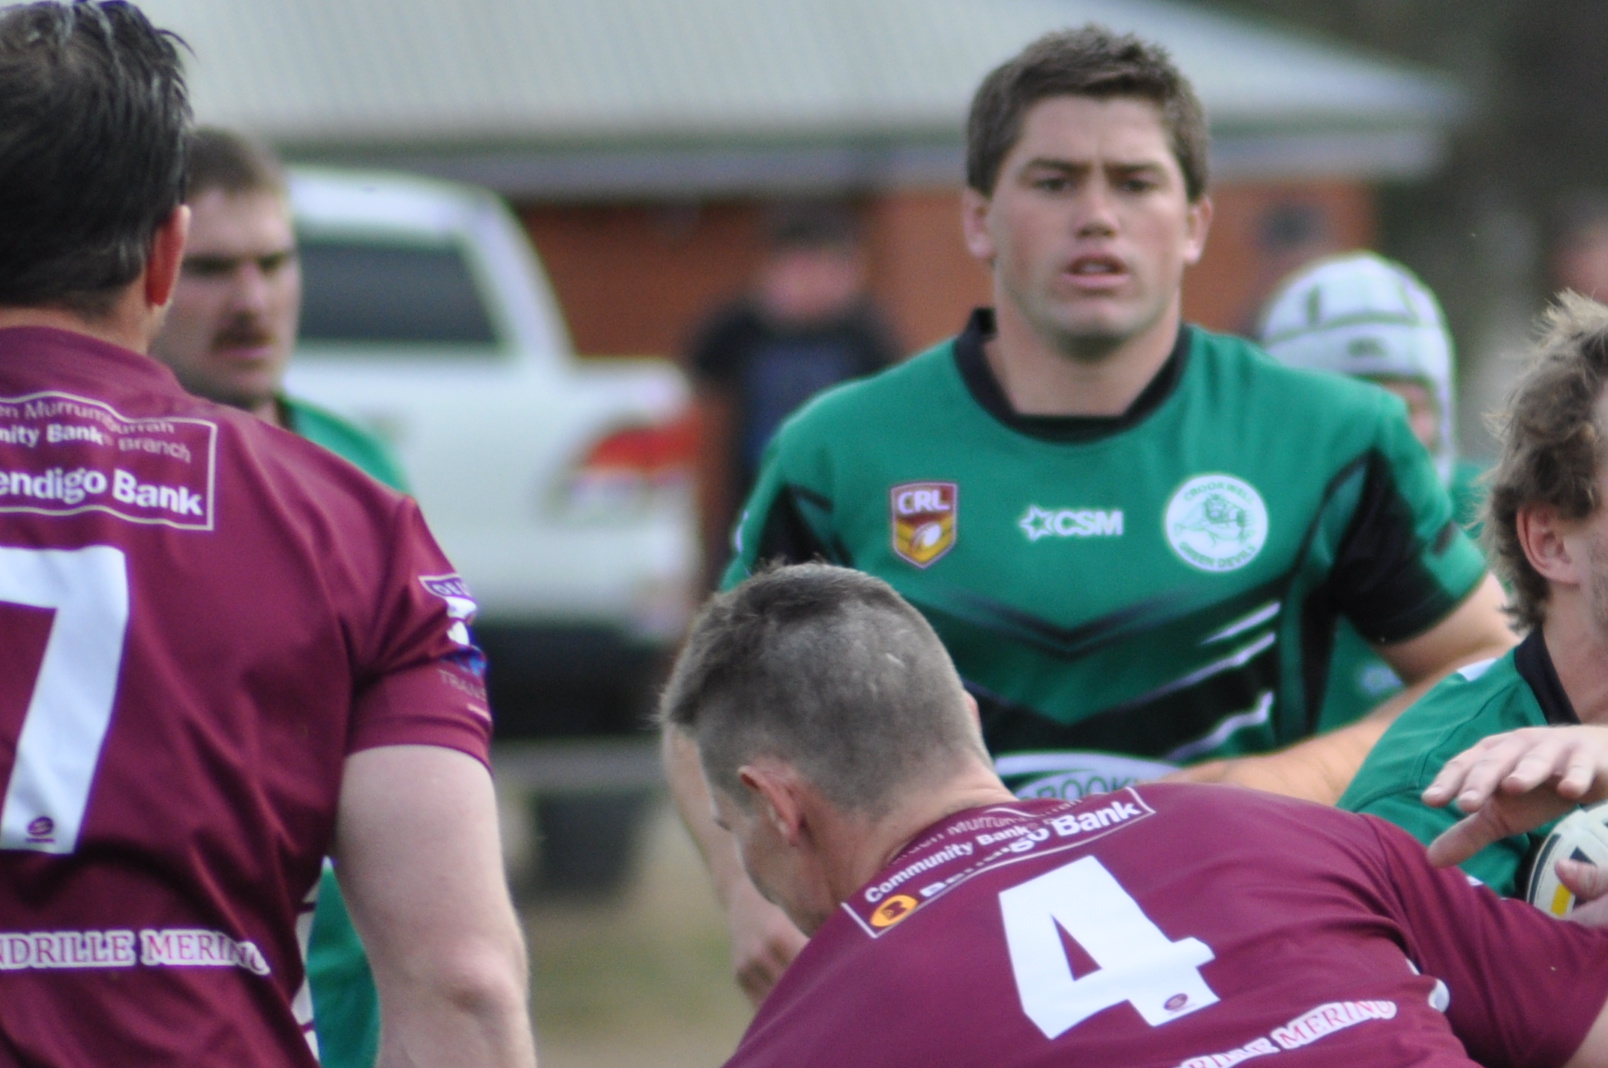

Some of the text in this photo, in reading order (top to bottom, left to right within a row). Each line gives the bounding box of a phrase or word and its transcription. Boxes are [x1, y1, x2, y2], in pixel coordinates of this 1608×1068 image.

[47, 423, 103, 446] Bank
[118, 437, 191, 464] Branch
[112, 468, 203, 516] Bank
[897, 487, 950, 515] CRL
[1053, 510, 1124, 536] CSM
[0, 544, 129, 855] 7
[1050, 800, 1142, 837] Bank
[864, 841, 974, 902] Community
[976, 826, 1031, 846] Bank
[998, 855, 1220, 1041] 4
